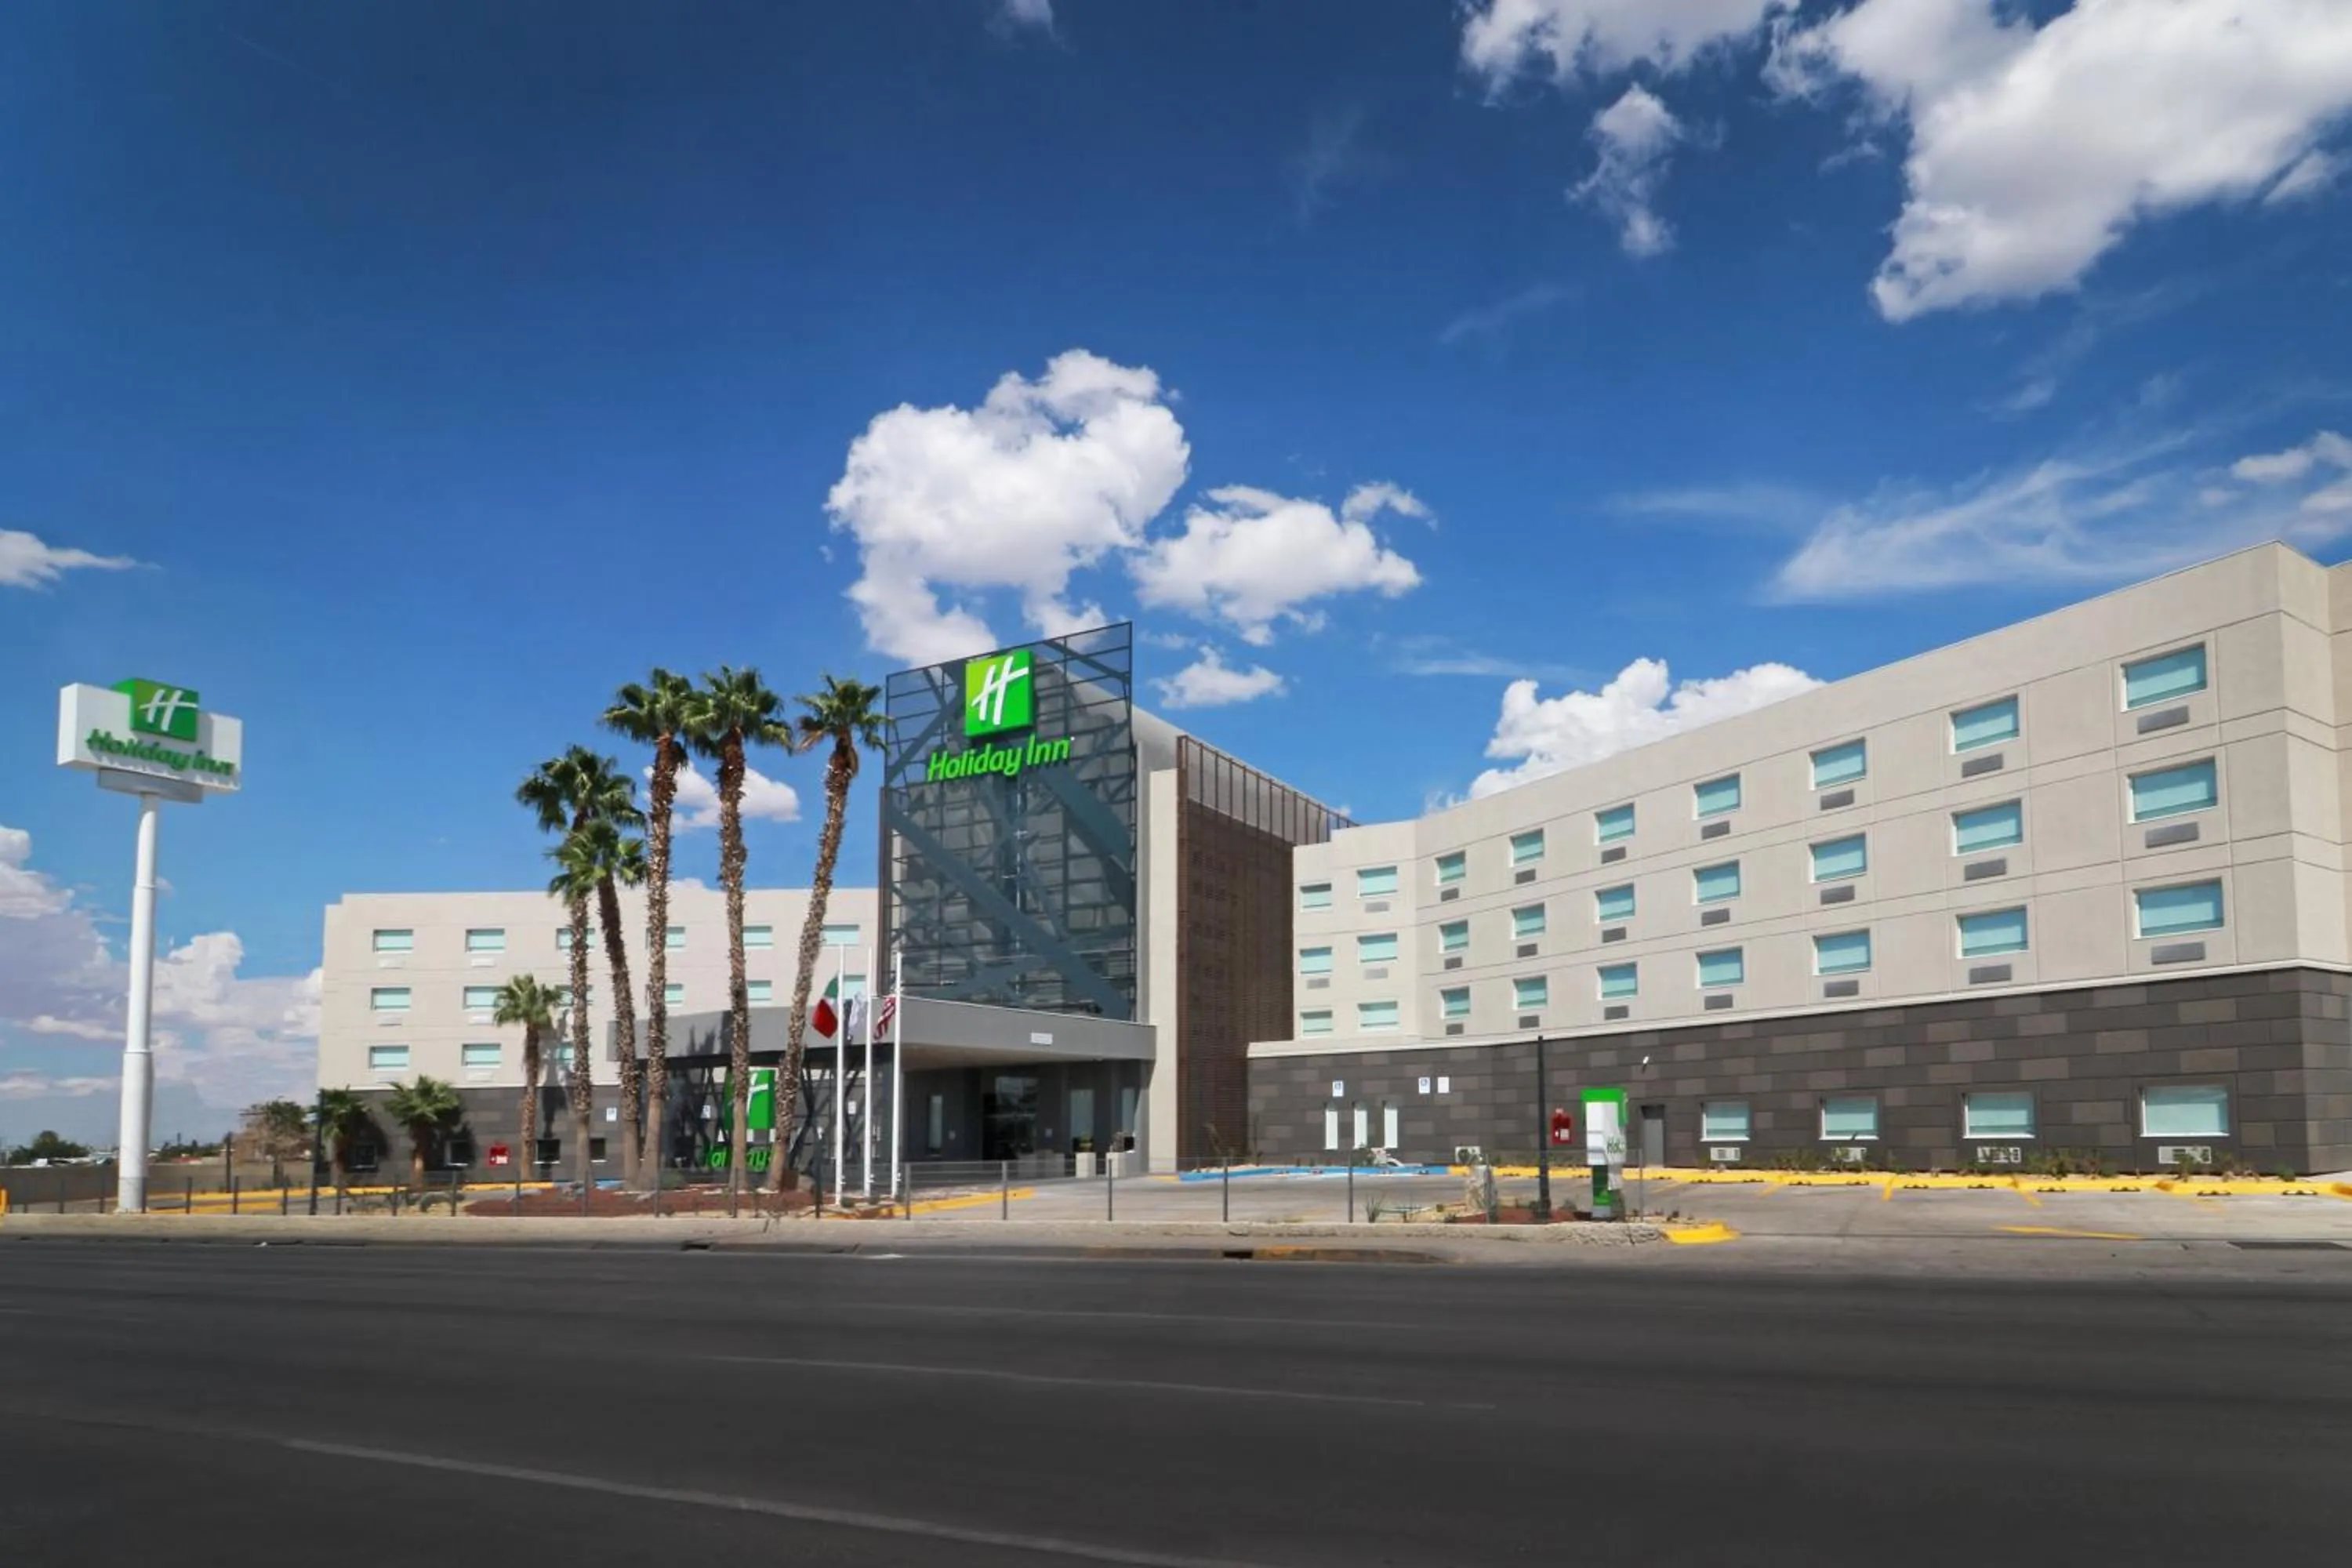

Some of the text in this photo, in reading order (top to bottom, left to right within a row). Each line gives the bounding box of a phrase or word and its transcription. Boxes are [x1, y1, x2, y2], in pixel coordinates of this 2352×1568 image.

[86, 728, 234, 776] Holiday Inn
[927, 733, 1070, 781] Holiday Inn
